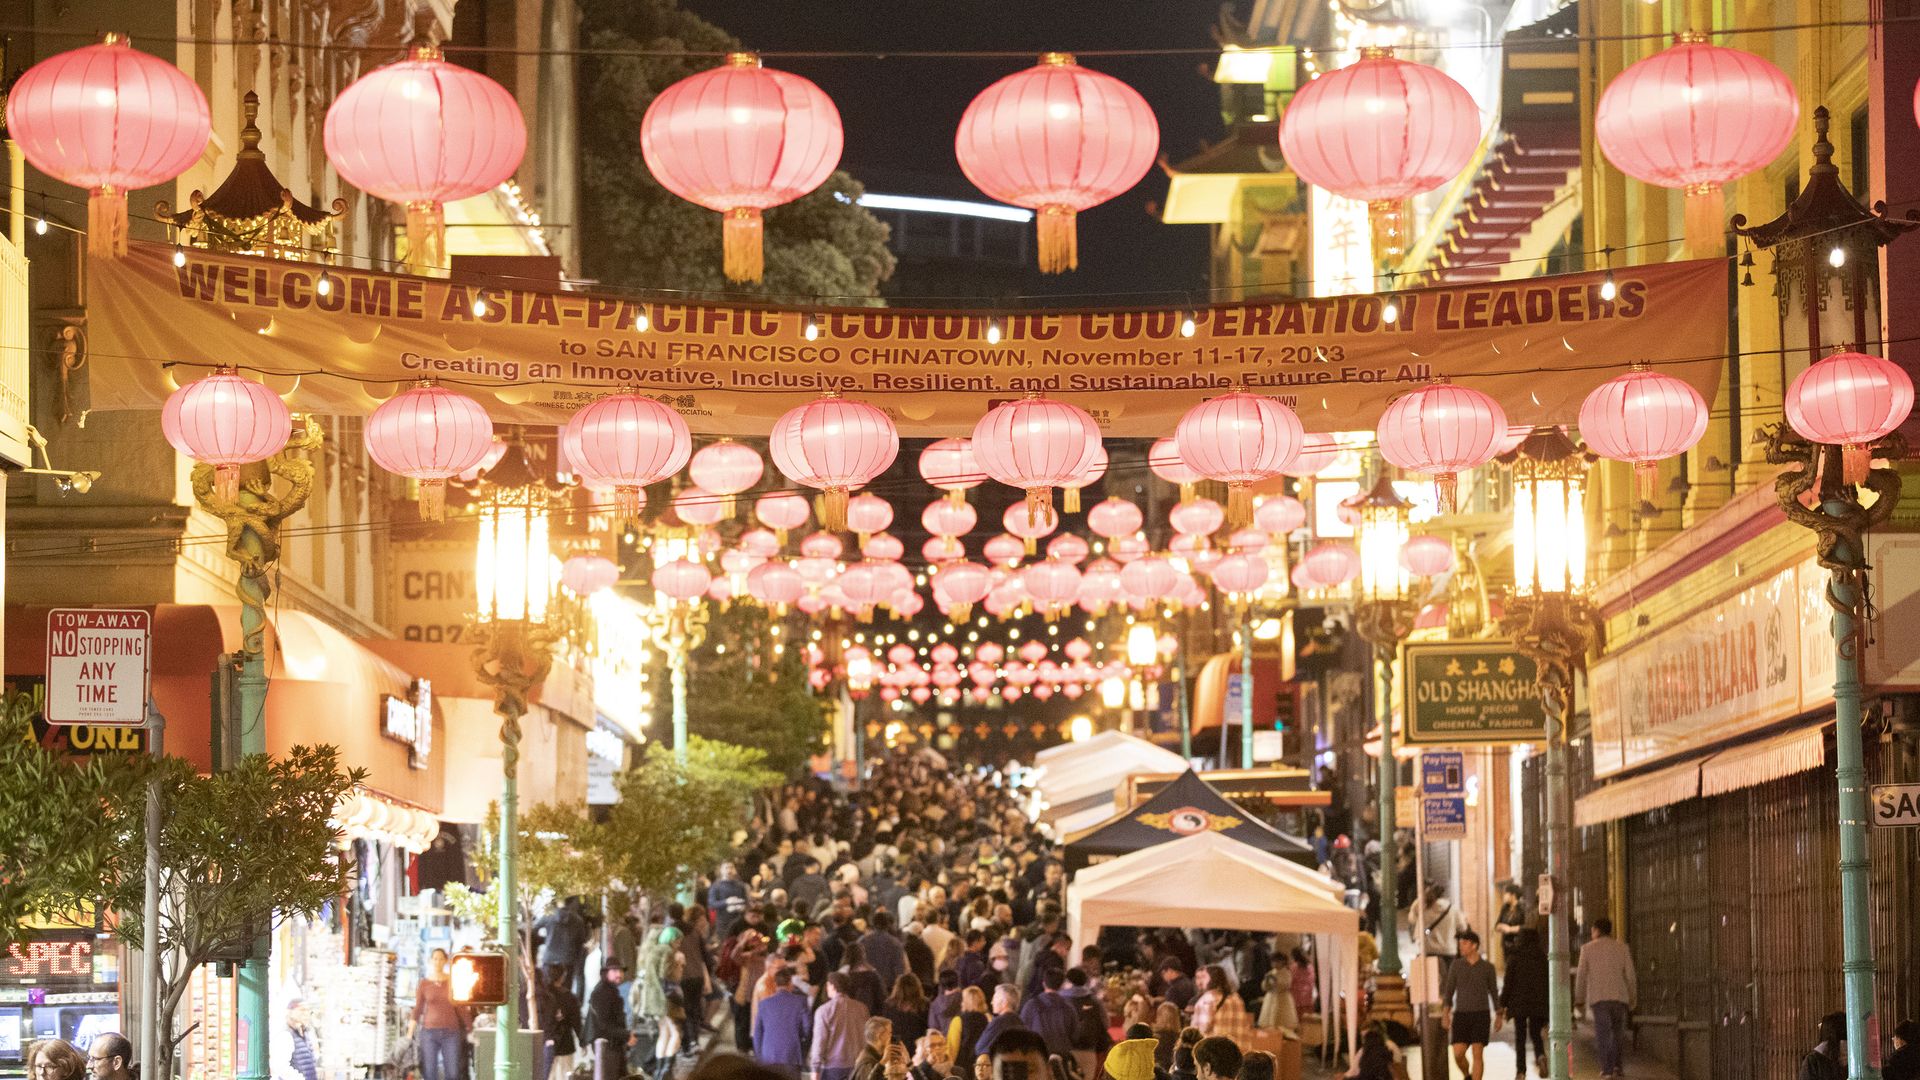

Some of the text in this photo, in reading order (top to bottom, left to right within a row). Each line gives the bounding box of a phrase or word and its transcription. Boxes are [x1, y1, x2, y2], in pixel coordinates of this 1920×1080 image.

[177, 263, 1646, 341] WELCOME ASIA-PACIFIC ECONOMIC COOPERATION LEADERS
[559, 339, 1345, 368] to SAN FRANCISCO CHINATOWN, November 11-17, 2023
[401, 352, 1431, 391] Creating an Innovative, Inclusive, Resilient, and Sustainable Future For All
[404, 569, 470, 600] CAN
[57, 613, 141, 628] TOW-AWAY
[52, 630, 142, 657] NO STOPPING
[79, 662, 116, 681] ANY
[1702, 621, 1759, 709] BAZAAR
[76, 685, 117, 703] TIME
[1418, 679, 1543, 703] OLD SHANGHA
[1446, 703, 1519, 716] HOME DECOR
[1432, 718, 1534, 730] ORIENTAL FASHION
[1879, 792, 1920, 819] SA
